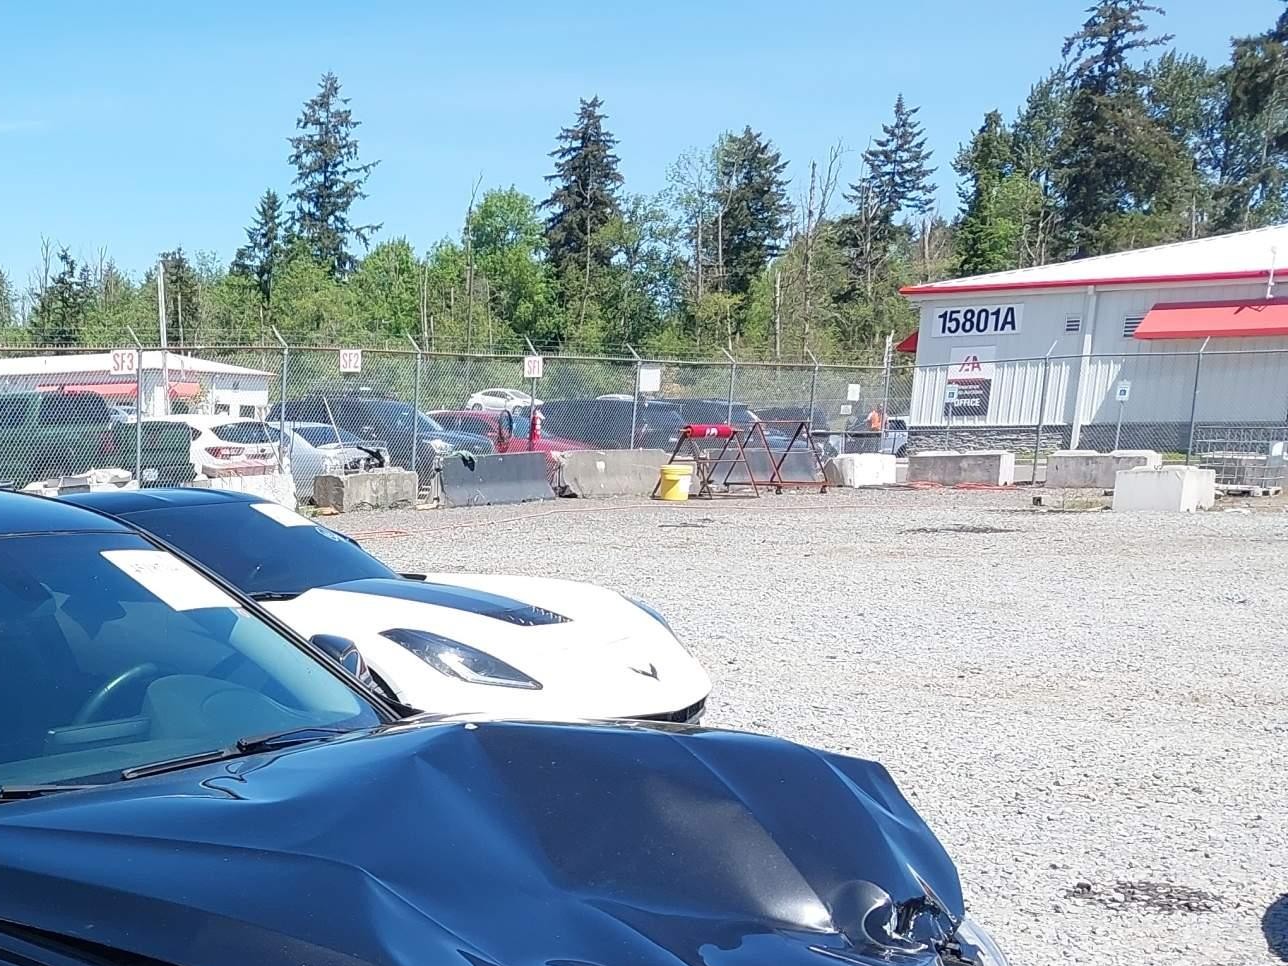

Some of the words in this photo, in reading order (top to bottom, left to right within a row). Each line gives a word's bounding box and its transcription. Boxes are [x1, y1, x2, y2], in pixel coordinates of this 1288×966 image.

[938, 307, 1016, 334] 15801A
[112, 352, 134, 371] SF3
[342, 352, 360, 369] SF2
[527, 360, 540, 375] SF1
[954, 398, 981, 407] OFFICE
